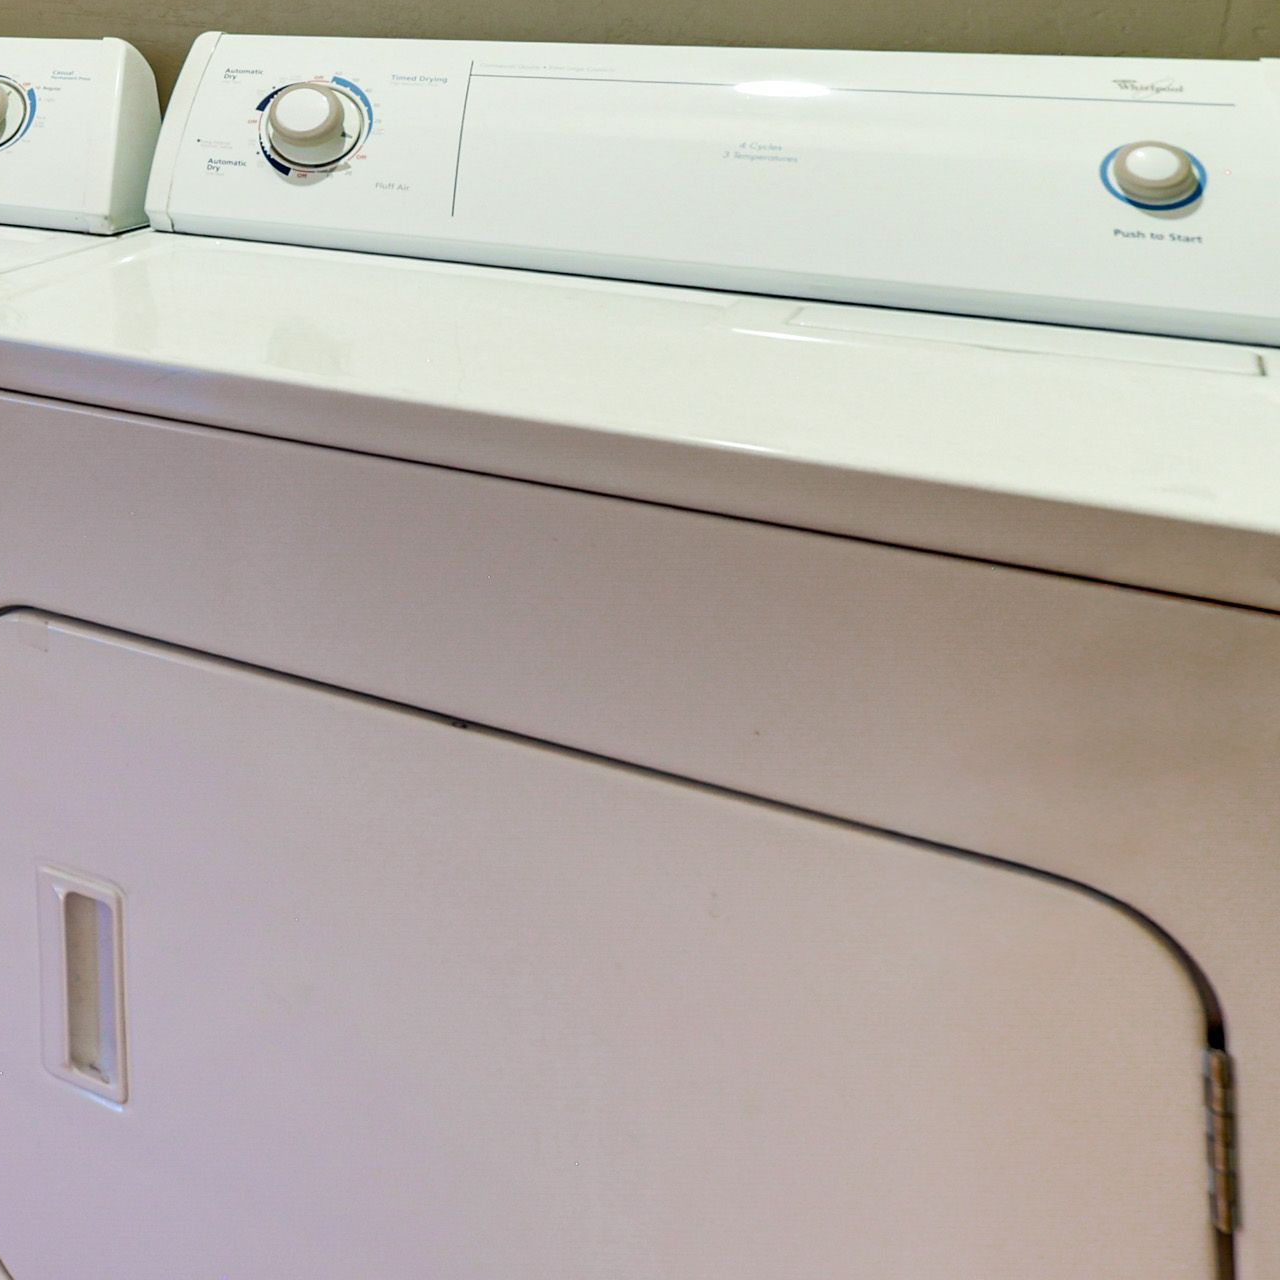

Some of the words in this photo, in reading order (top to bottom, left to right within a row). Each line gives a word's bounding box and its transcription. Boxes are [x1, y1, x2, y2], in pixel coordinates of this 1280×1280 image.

[224, 67, 263, 75] Automatic
[419, 75, 448, 84] Drying
[1111, 78, 1185, 94] Whirlpool
[208, 158, 247, 167] Automatic
[375, 182, 394, 190] Fluff
[1113, 227, 1146, 241] Push
[1149, 231, 1165, 241] to
[1169, 231, 1204, 245] Start
